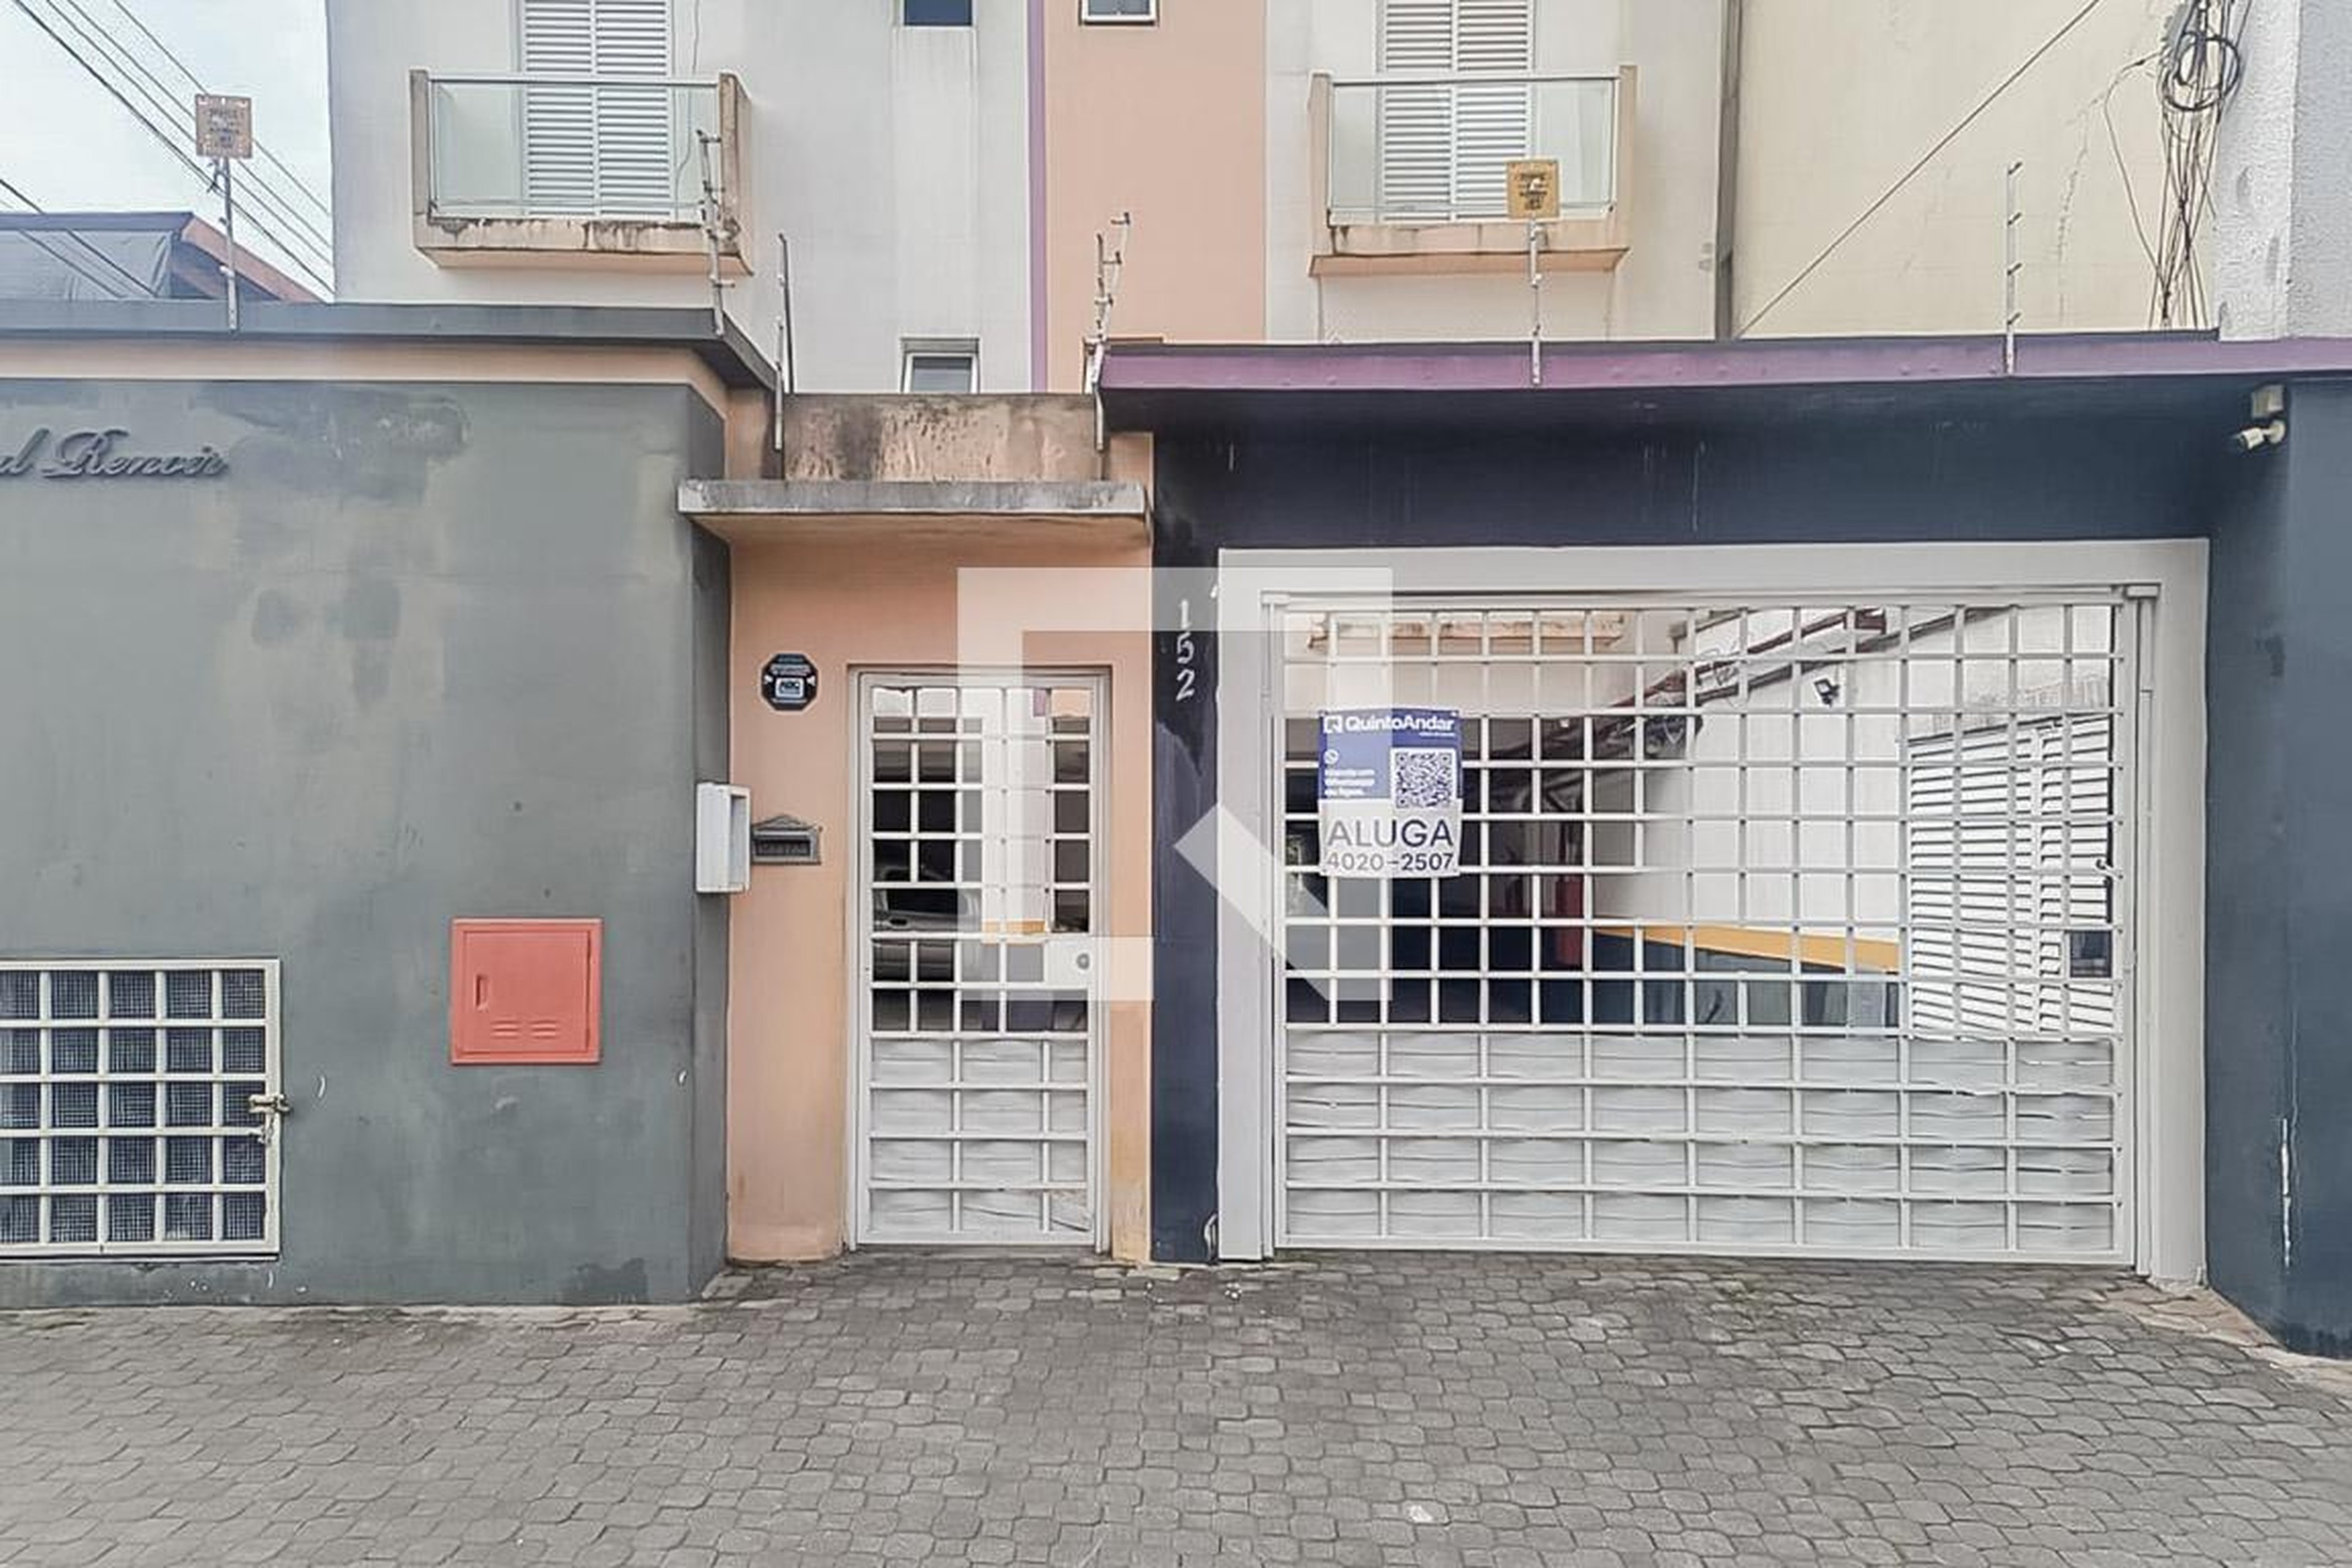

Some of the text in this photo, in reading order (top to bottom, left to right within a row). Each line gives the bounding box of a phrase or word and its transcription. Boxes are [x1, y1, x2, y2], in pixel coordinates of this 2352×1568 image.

[1175, 598, 1195, 701] 152
[1345, 715, 1455, 732] QuintoAndar
[1327, 819, 1454, 848] ALUGA
[1325, 851, 1454, 872] 4020-2507
